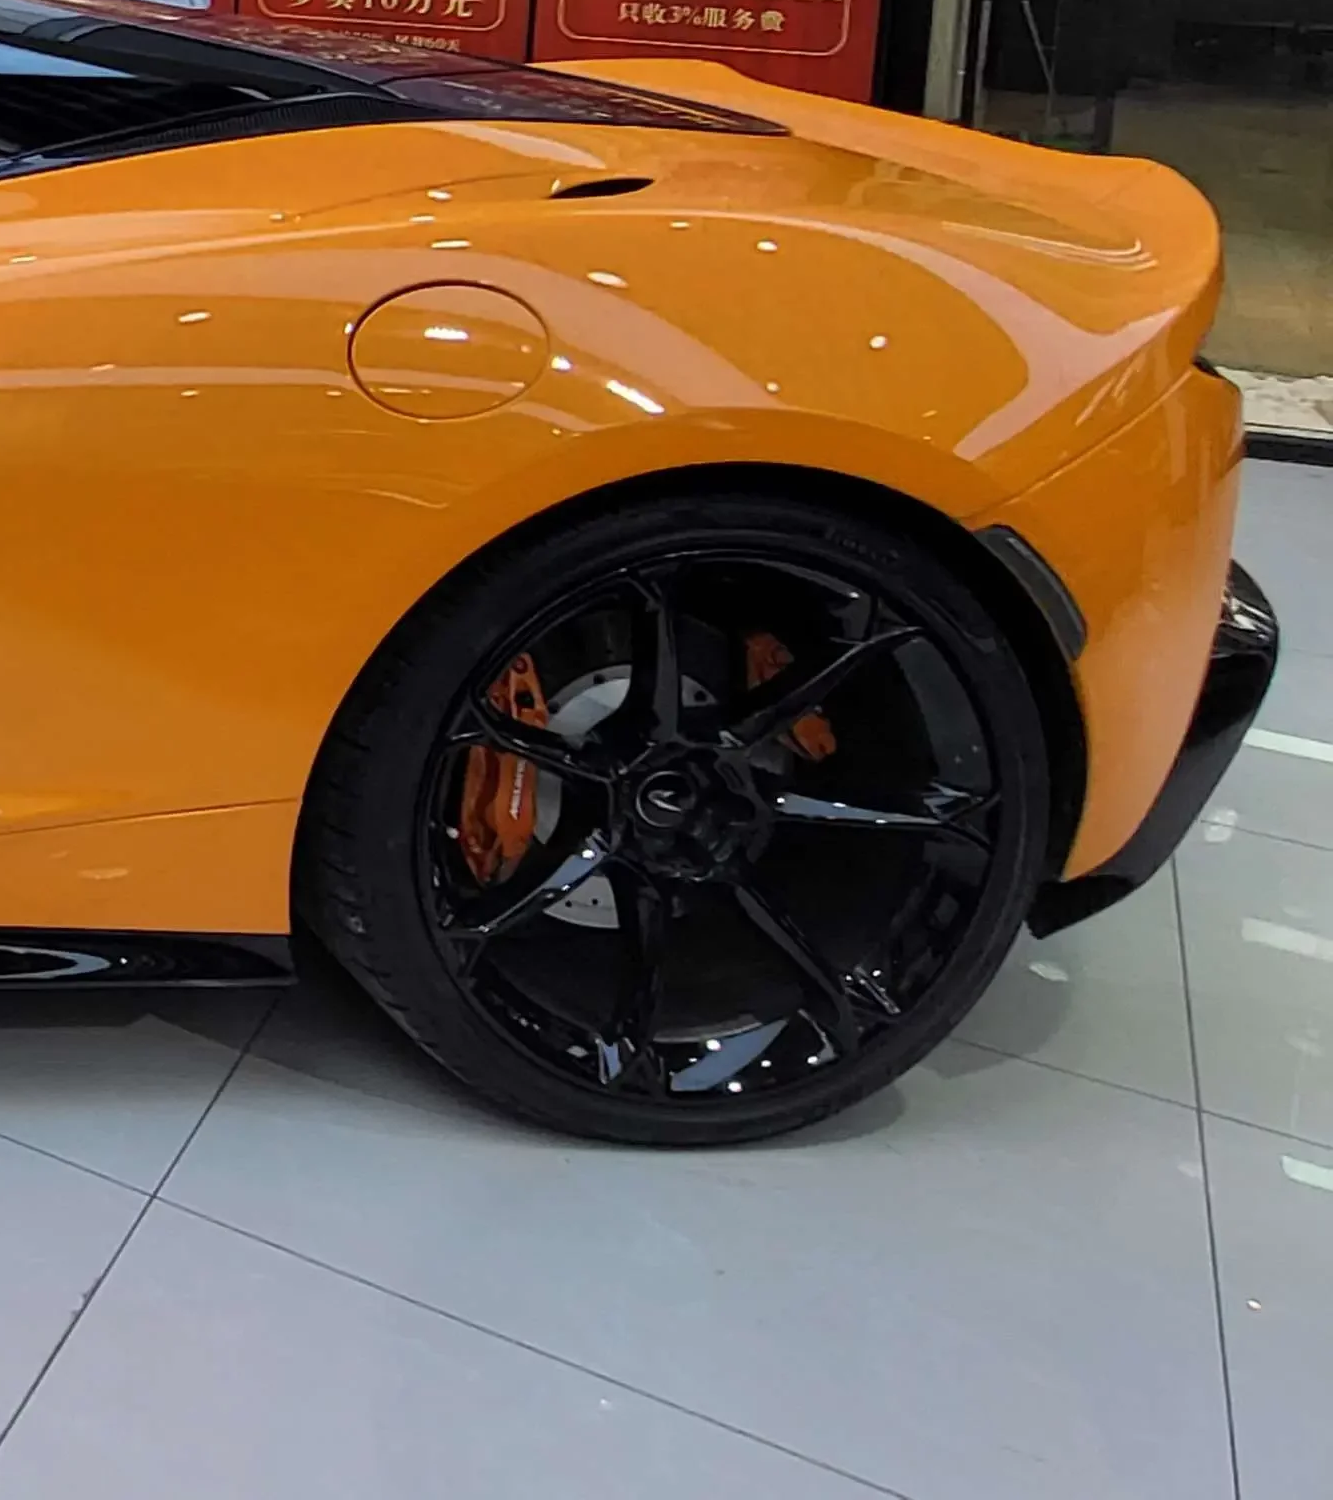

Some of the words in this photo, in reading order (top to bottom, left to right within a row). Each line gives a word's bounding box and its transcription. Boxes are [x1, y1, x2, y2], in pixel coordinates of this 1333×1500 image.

[617, 2, 786, 32] 只收3%服务费
